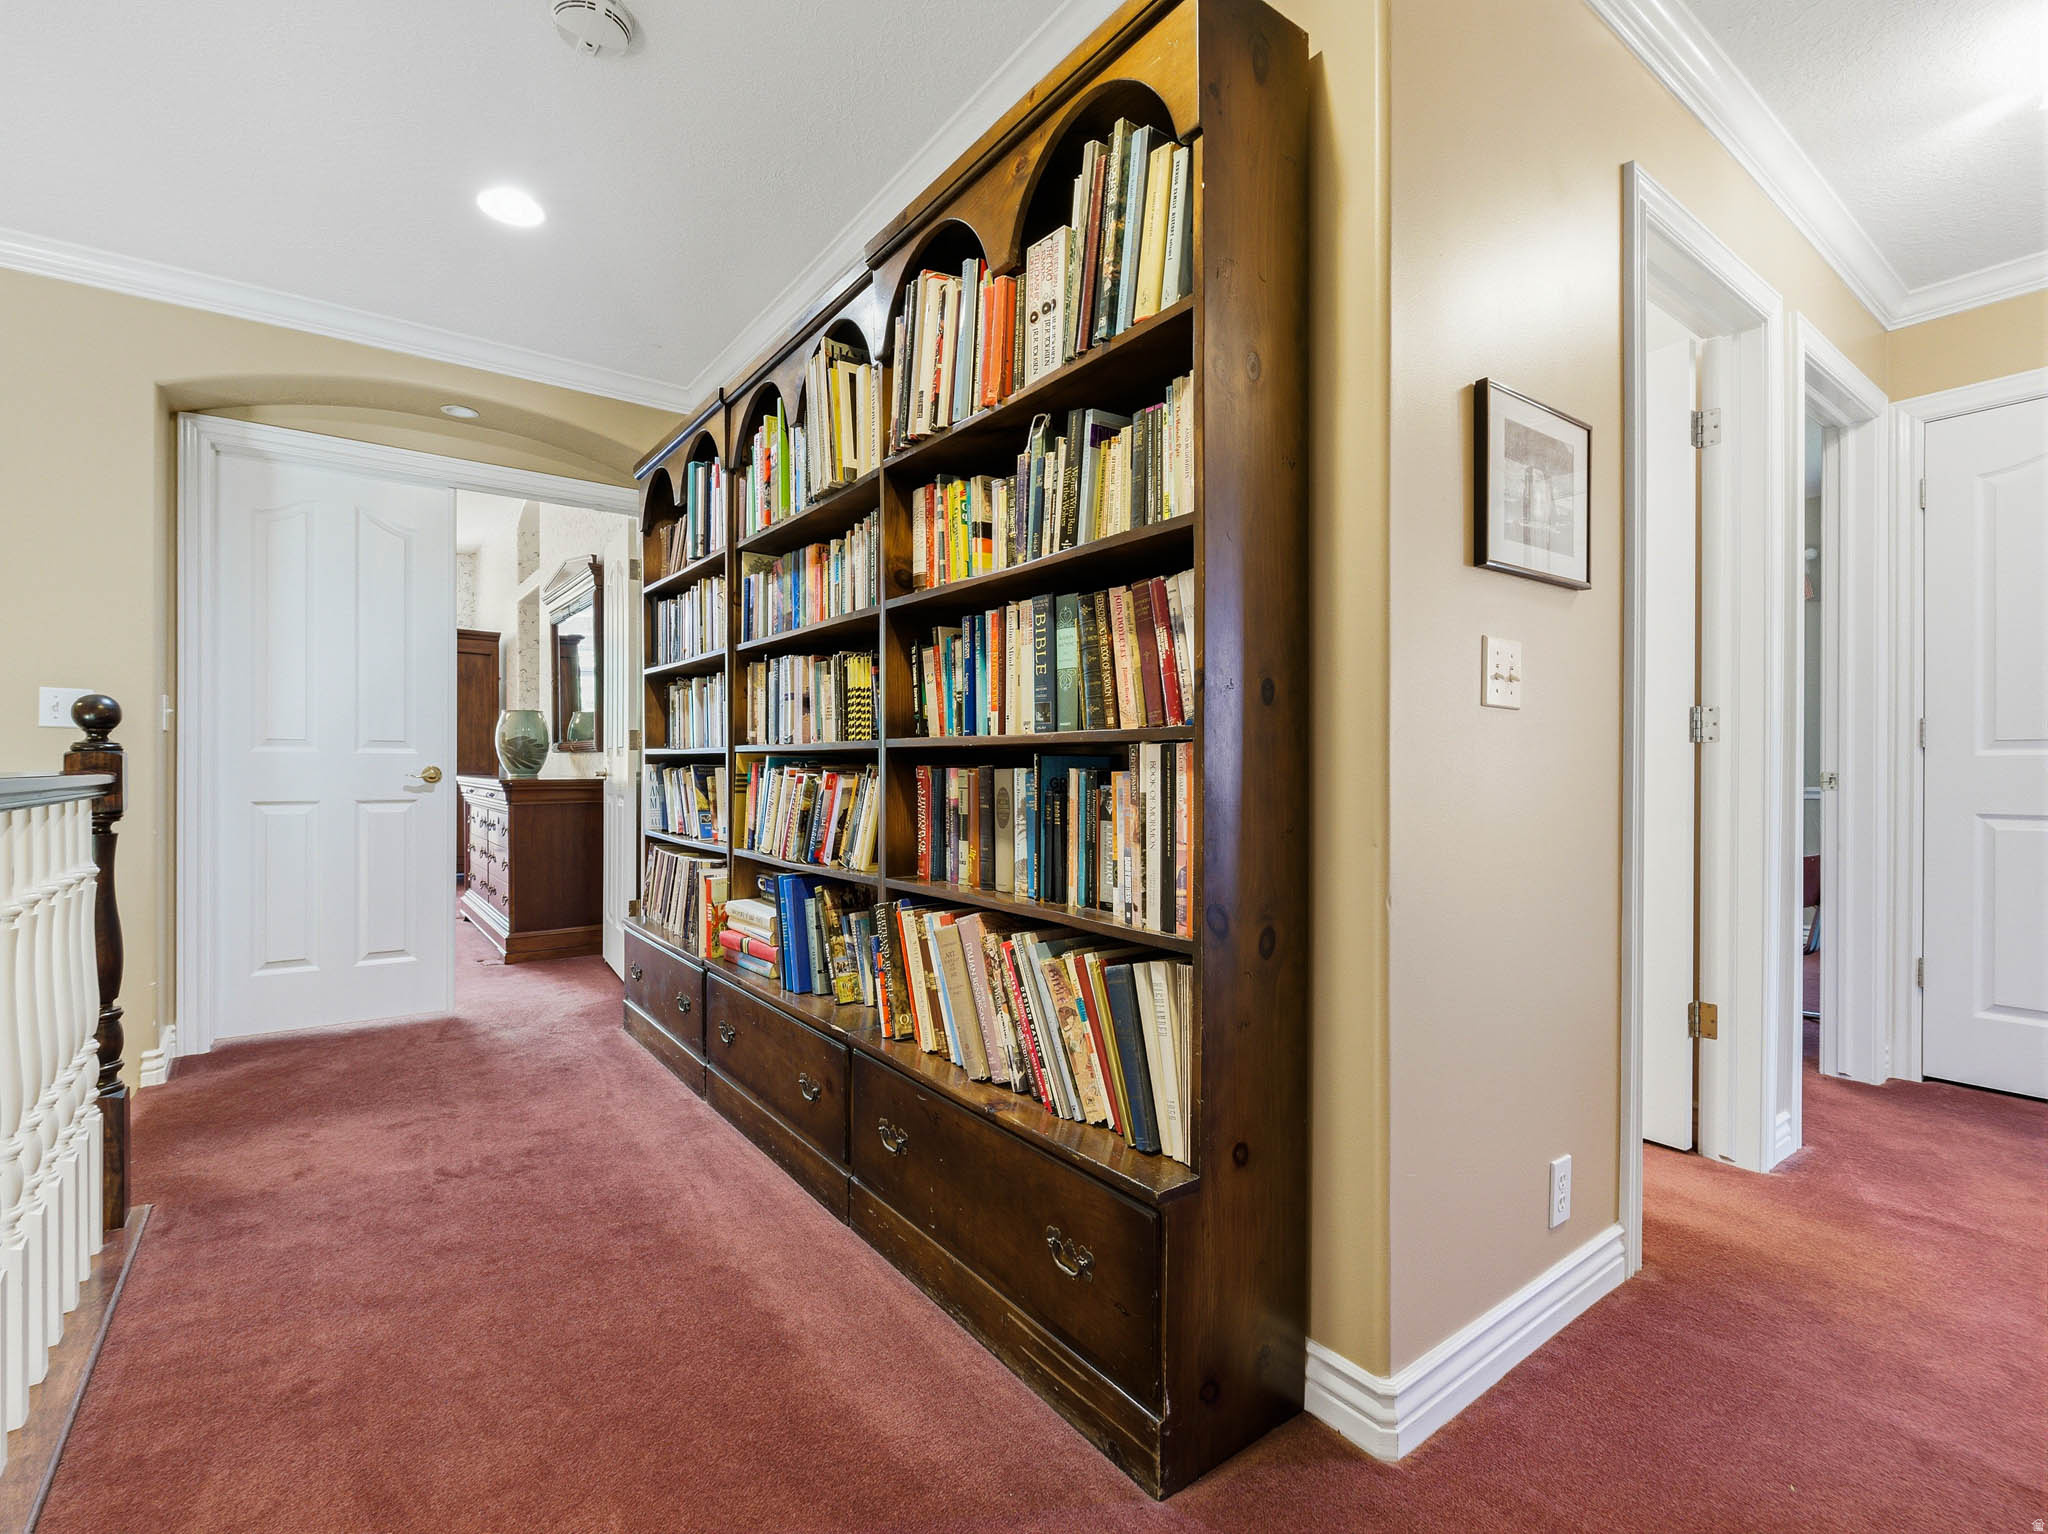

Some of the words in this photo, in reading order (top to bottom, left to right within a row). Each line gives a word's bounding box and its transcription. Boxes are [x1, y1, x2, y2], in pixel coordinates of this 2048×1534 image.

[1069, 465, 1079, 496] Women
[1035, 612, 1047, 677] BIBLE
[1149, 760, 1157, 785] BOOK
[1149, 790, 1157, 803] OF
[1149, 805, 1157, 850] MORMON
[1021, 986, 1032, 1021] DESIGN
